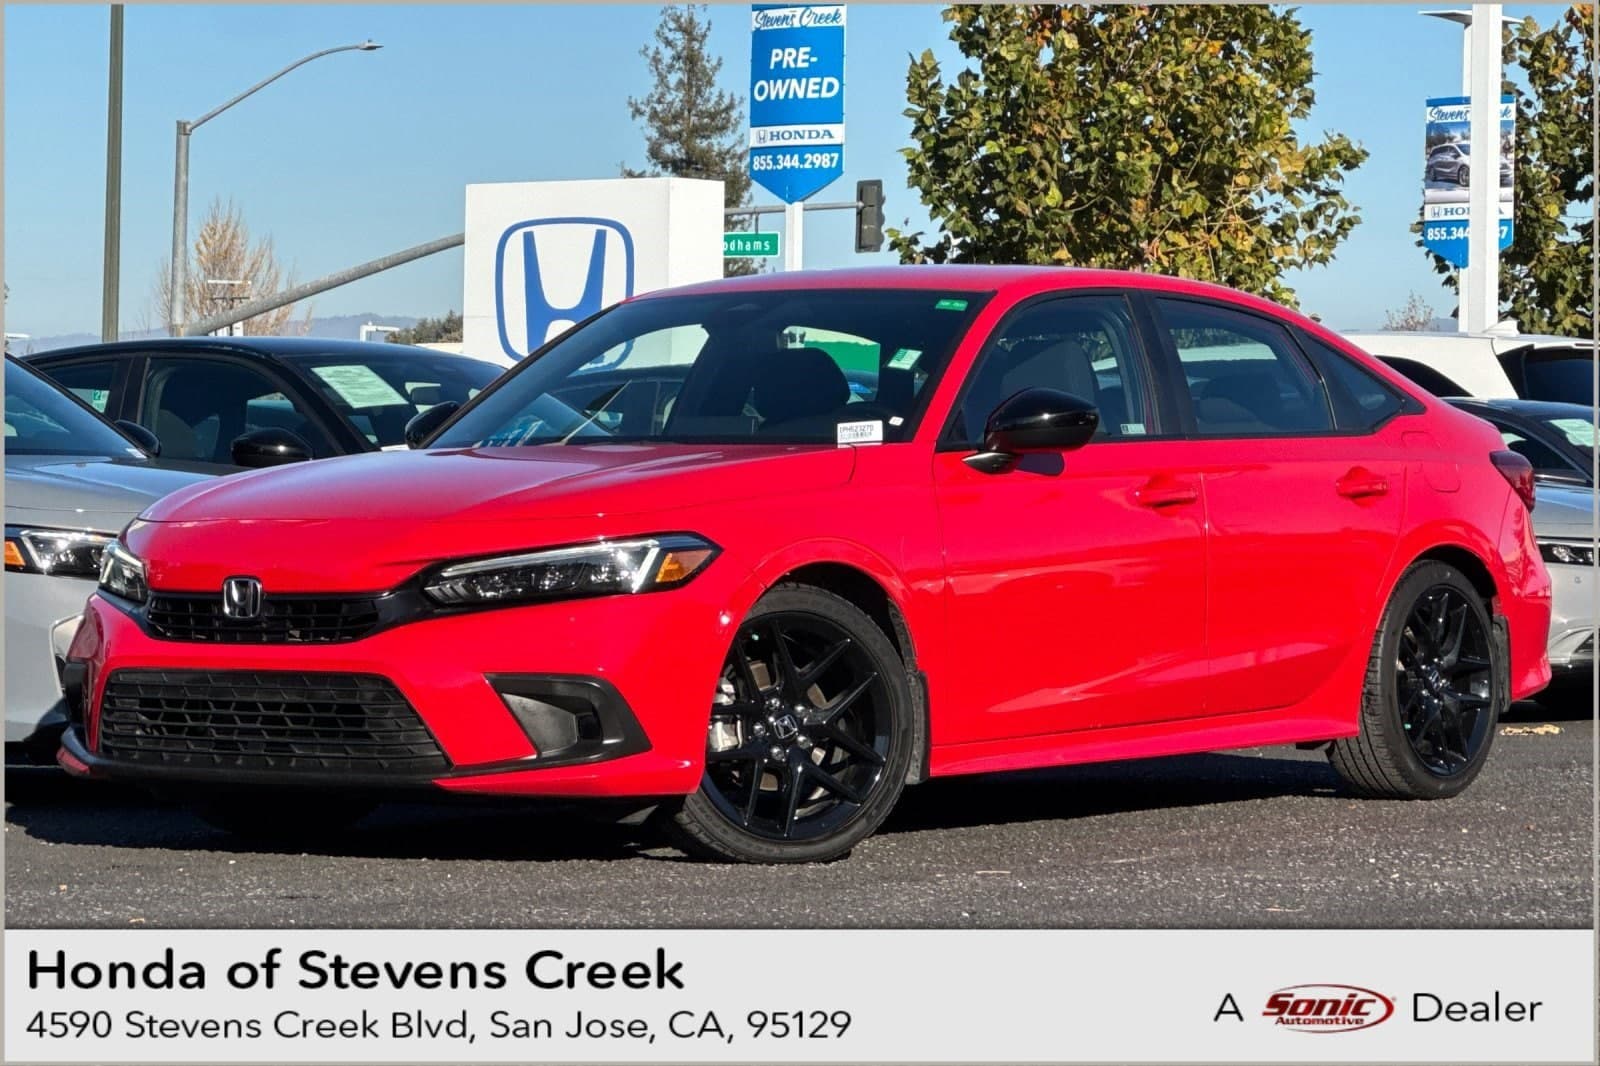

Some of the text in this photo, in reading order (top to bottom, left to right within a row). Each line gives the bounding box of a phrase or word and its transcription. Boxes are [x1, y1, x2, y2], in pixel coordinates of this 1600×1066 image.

[755, 7, 842, 30] Stevens Creek
[769, 47, 818, 70] PRE-
[753, 77, 839, 102] OWNED
[1429, 106, 1470, 123] Stevens
[769, 129, 834, 142] HONDA
[753, 153, 839, 171] 855.344.2987
